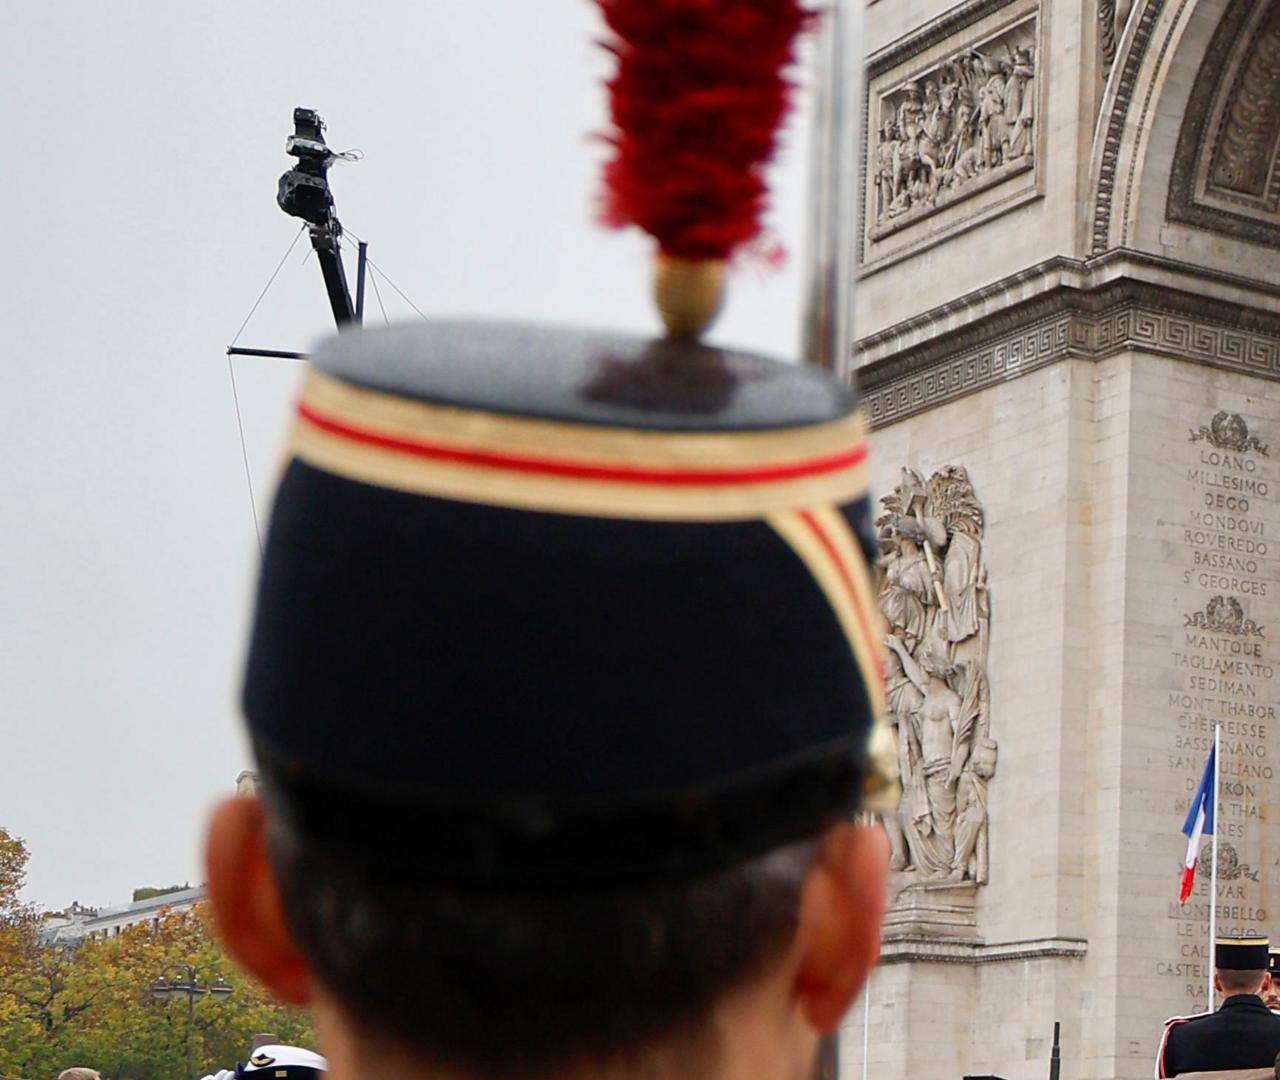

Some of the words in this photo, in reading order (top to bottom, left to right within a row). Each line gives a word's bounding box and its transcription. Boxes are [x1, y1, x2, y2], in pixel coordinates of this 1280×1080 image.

[1200, 450, 1256, 472] LOANO
[1188, 469, 1268, 496] MILLESIMO
[1205, 492, 1249, 513] DEGO
[1190, 511, 1264, 536] MONDOVI
[1184, 530, 1268, 556] ROVEREDO
[1194, 552, 1257, 574] BASSANO
[1198, 573, 1267, 596] GEORGES
[1186, 634, 1262, 658] MANTOUE
[1172, 652, 1274, 679] TAGLIAMENTO
[1168, 694, 1216, 710] MONT
[1218, 700, 1277, 720] THABOR
[1230, 803, 1266, 820] THAL
[1216, 884, 1246, 898] VAR
[1177, 923, 1193, 937] LE
[1200, 924, 1257, 936] MNCIO
